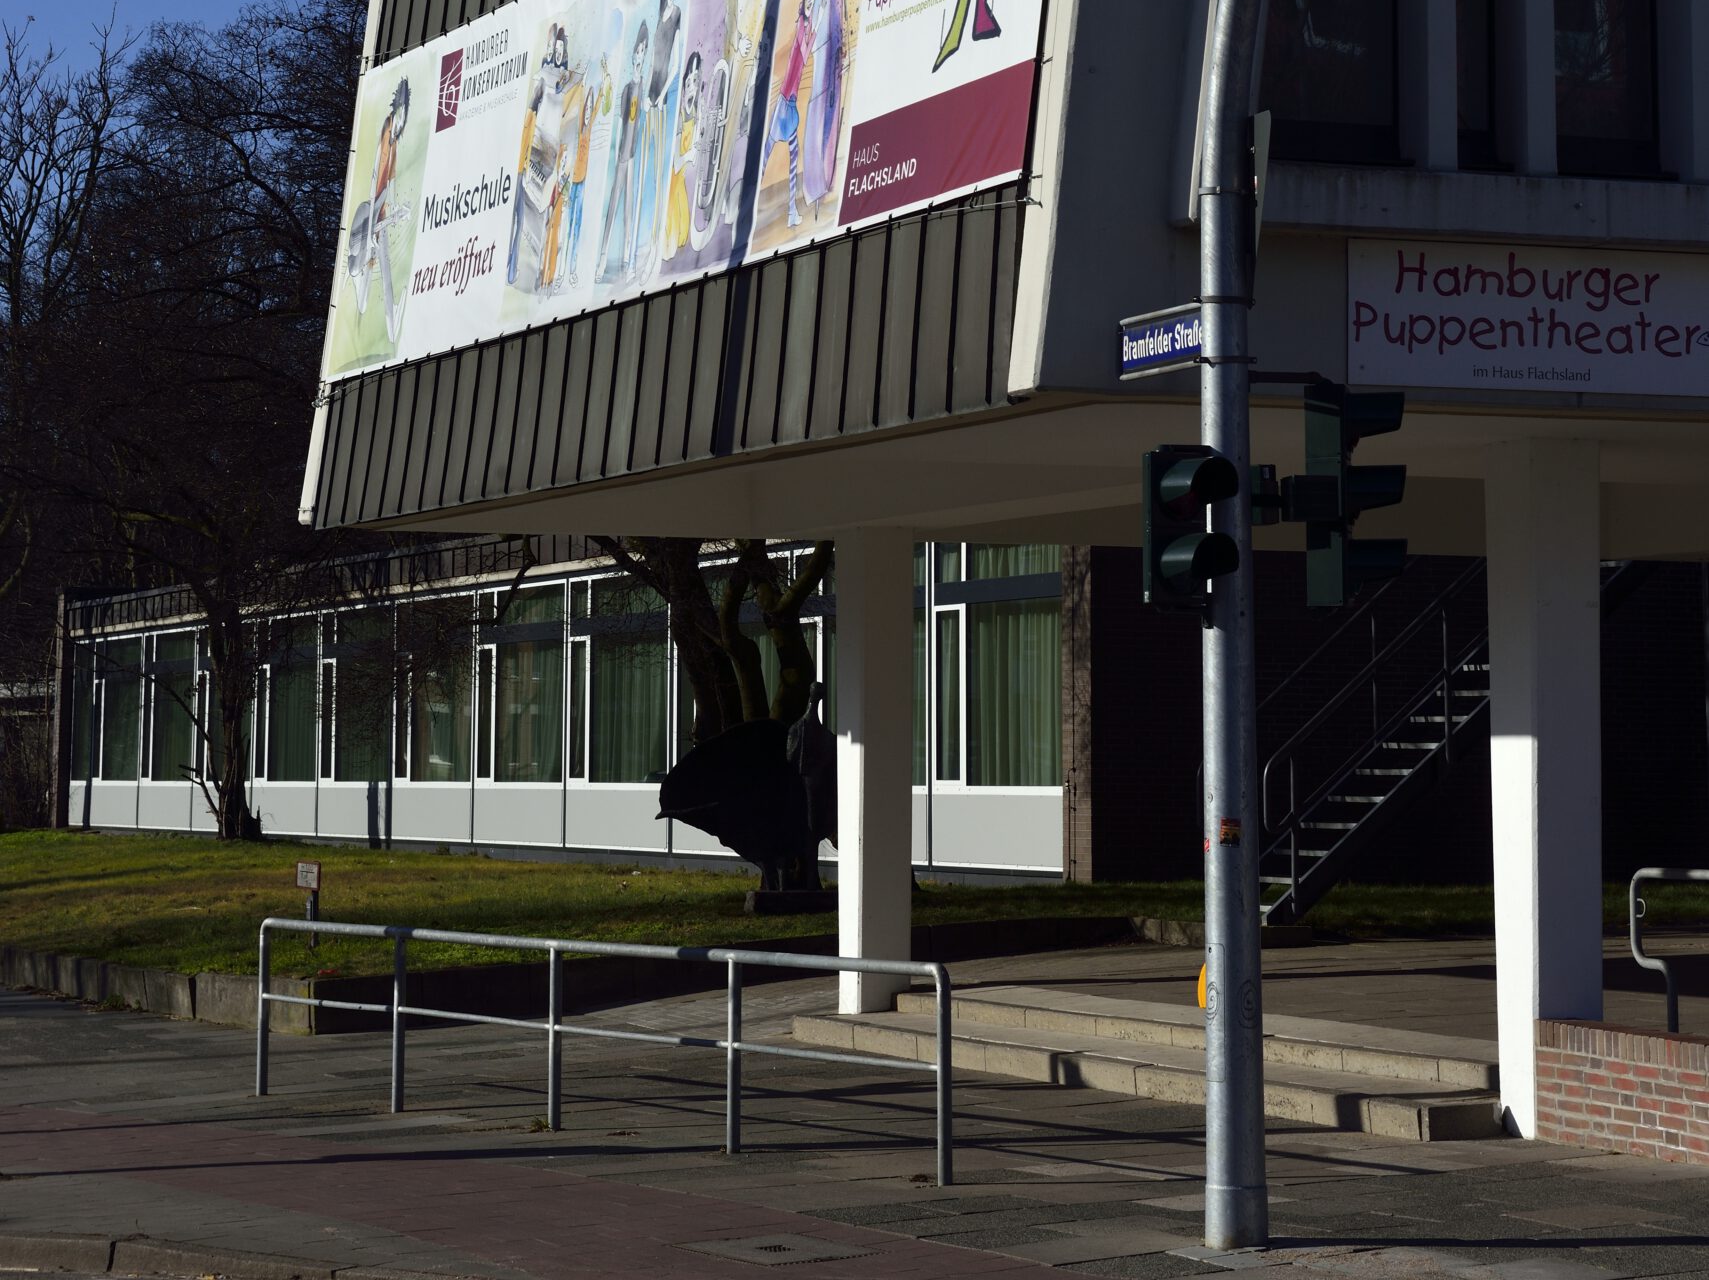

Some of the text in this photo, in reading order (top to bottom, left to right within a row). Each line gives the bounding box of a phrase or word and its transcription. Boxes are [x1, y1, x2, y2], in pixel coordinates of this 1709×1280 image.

[465, 29, 509, 70] HAMBURGER
[462, 51, 528, 102] KONSERVATORIUM
[848, 158, 917, 198] FLACHSLAND
[853, 143, 880, 169] HAUS
[422, 166, 511, 233] Musikschule
[412, 235, 496, 297] neu eröffnet
[1395, 249, 1660, 312] Hamburger
[1123, 327, 1173, 362] Bramfelder
[1353, 300, 1701, 358] Puppentheater
[1472, 364, 1591, 382] im Haus Flachsland
